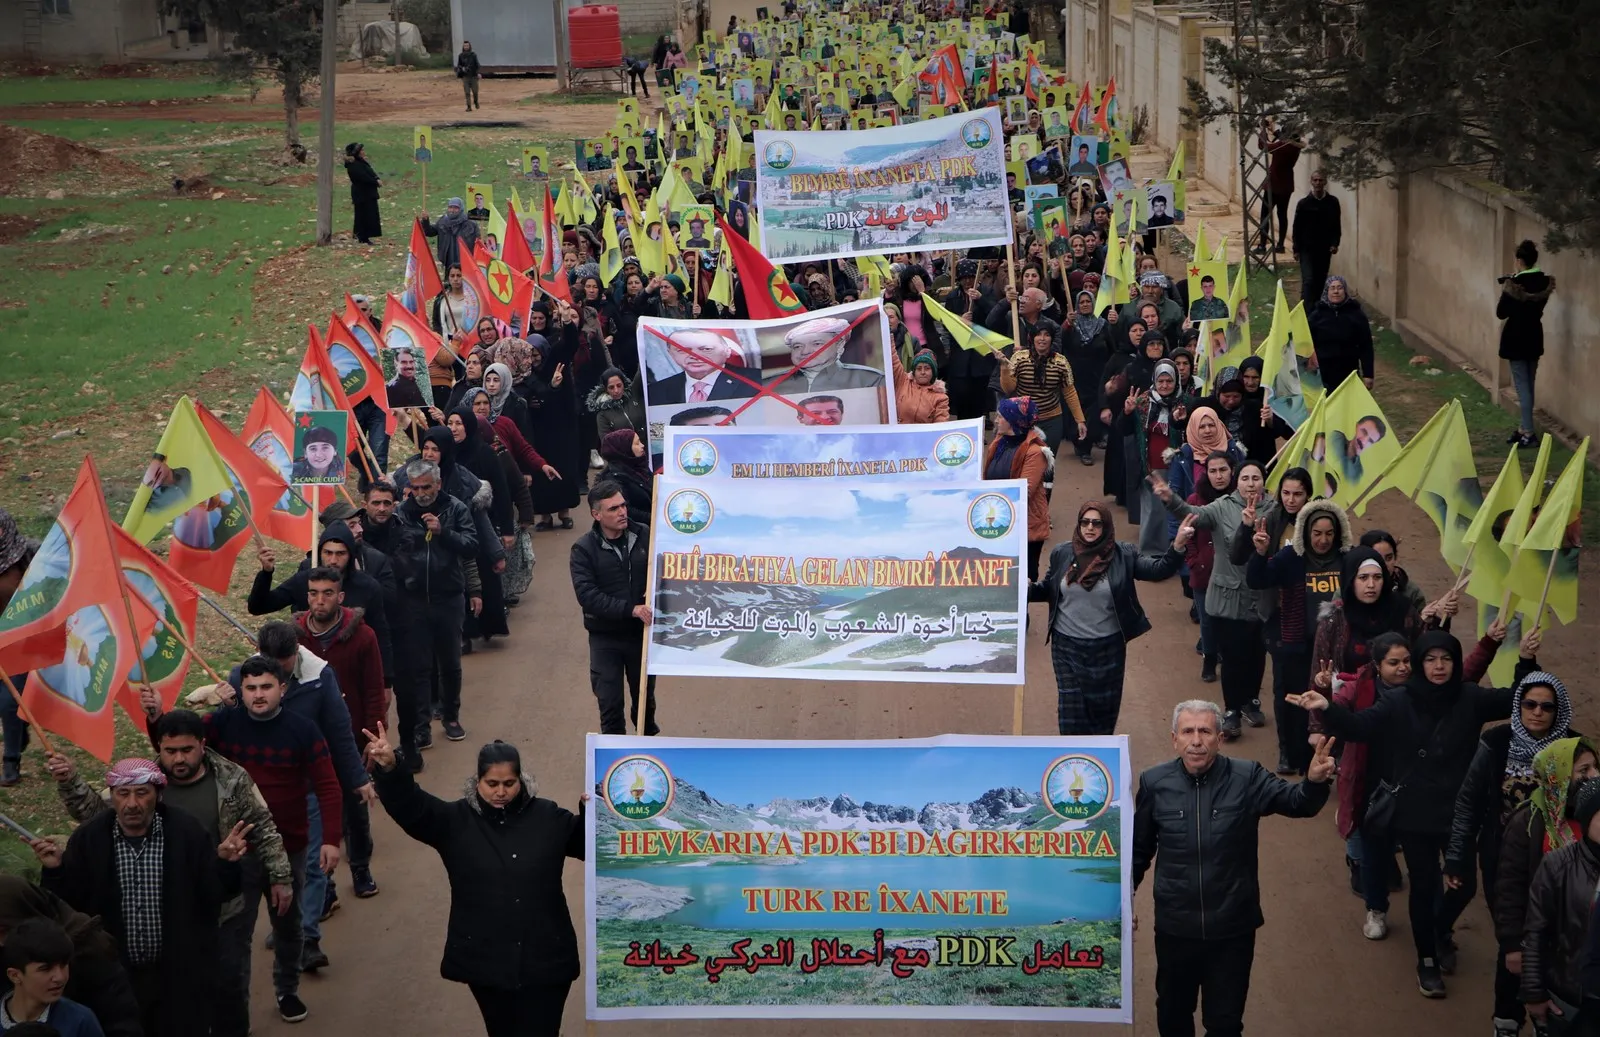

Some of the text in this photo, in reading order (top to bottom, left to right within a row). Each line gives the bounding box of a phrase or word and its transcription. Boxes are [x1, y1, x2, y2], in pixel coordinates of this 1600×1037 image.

[790, 155, 978, 194] BIMRÊ ÎXANETA PDK
[825, 210, 864, 230] PDK
[912, 201, 949, 226] الموت
[732, 457, 928, 478] EM LI HEMBERÎ ÎXANETA PDK
[661, 544, 1013, 588] BIJÎ BIRATIYA GELAN BIMRÊ ÎXANET
[683, 606, 997, 641] تحيا أخوة الشعوب والموت للخيانة
[618, 830, 1117, 857] HEVKARIYA PDK BI DAGIRKERIYA
[742, 883, 1008, 915] TURK RE ÎXANETE
[624, 928, 1104, 983] تعامل PDK مع أحتلال التركي خيانة
